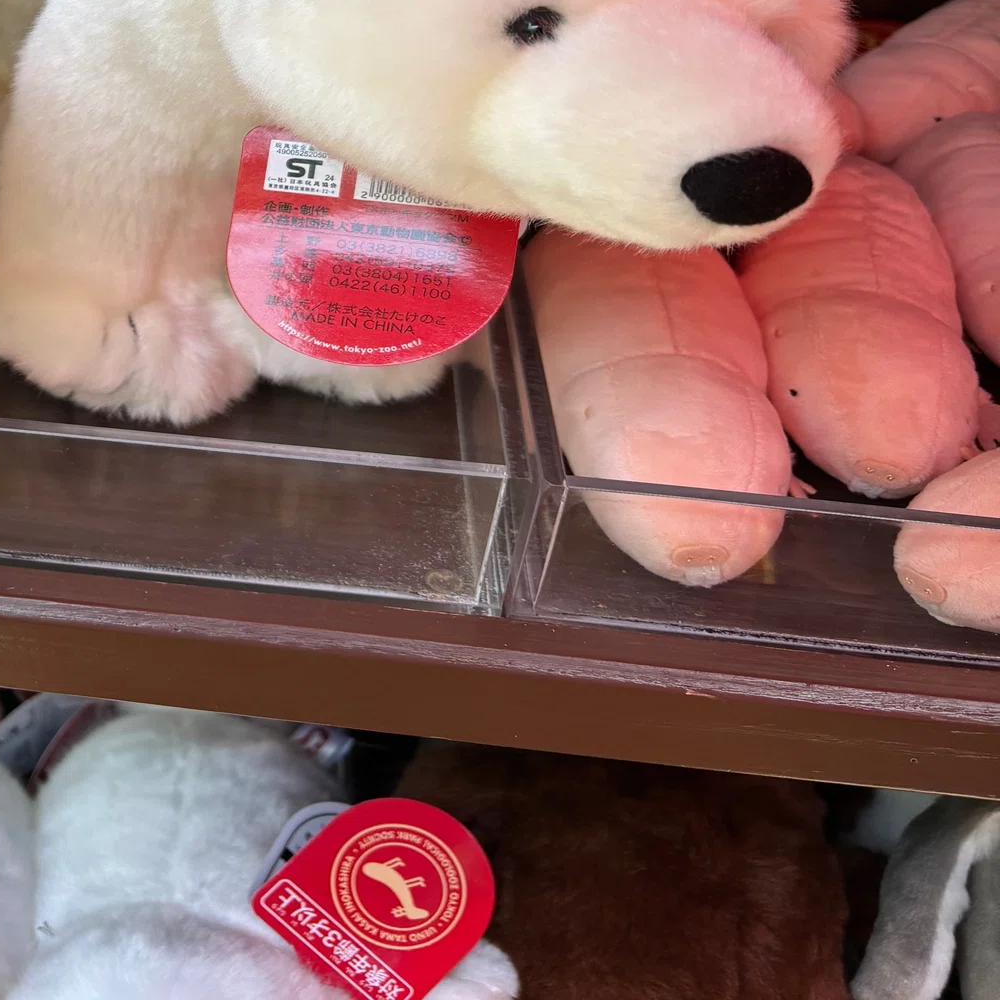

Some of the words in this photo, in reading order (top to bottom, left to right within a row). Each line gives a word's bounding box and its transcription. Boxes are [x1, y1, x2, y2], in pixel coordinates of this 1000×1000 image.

[286, 158, 323, 179] ST
[332, 264, 451, 287] 03(3804)1651
[329, 276, 451, 300] 0422(46)1100
[291, 311, 335, 326] MADE
[340, 317, 358, 328] IN
[364, 319, 415, 335] CHINA
[278, 320, 423, 355] https://www.tokyo-zoo.net/
